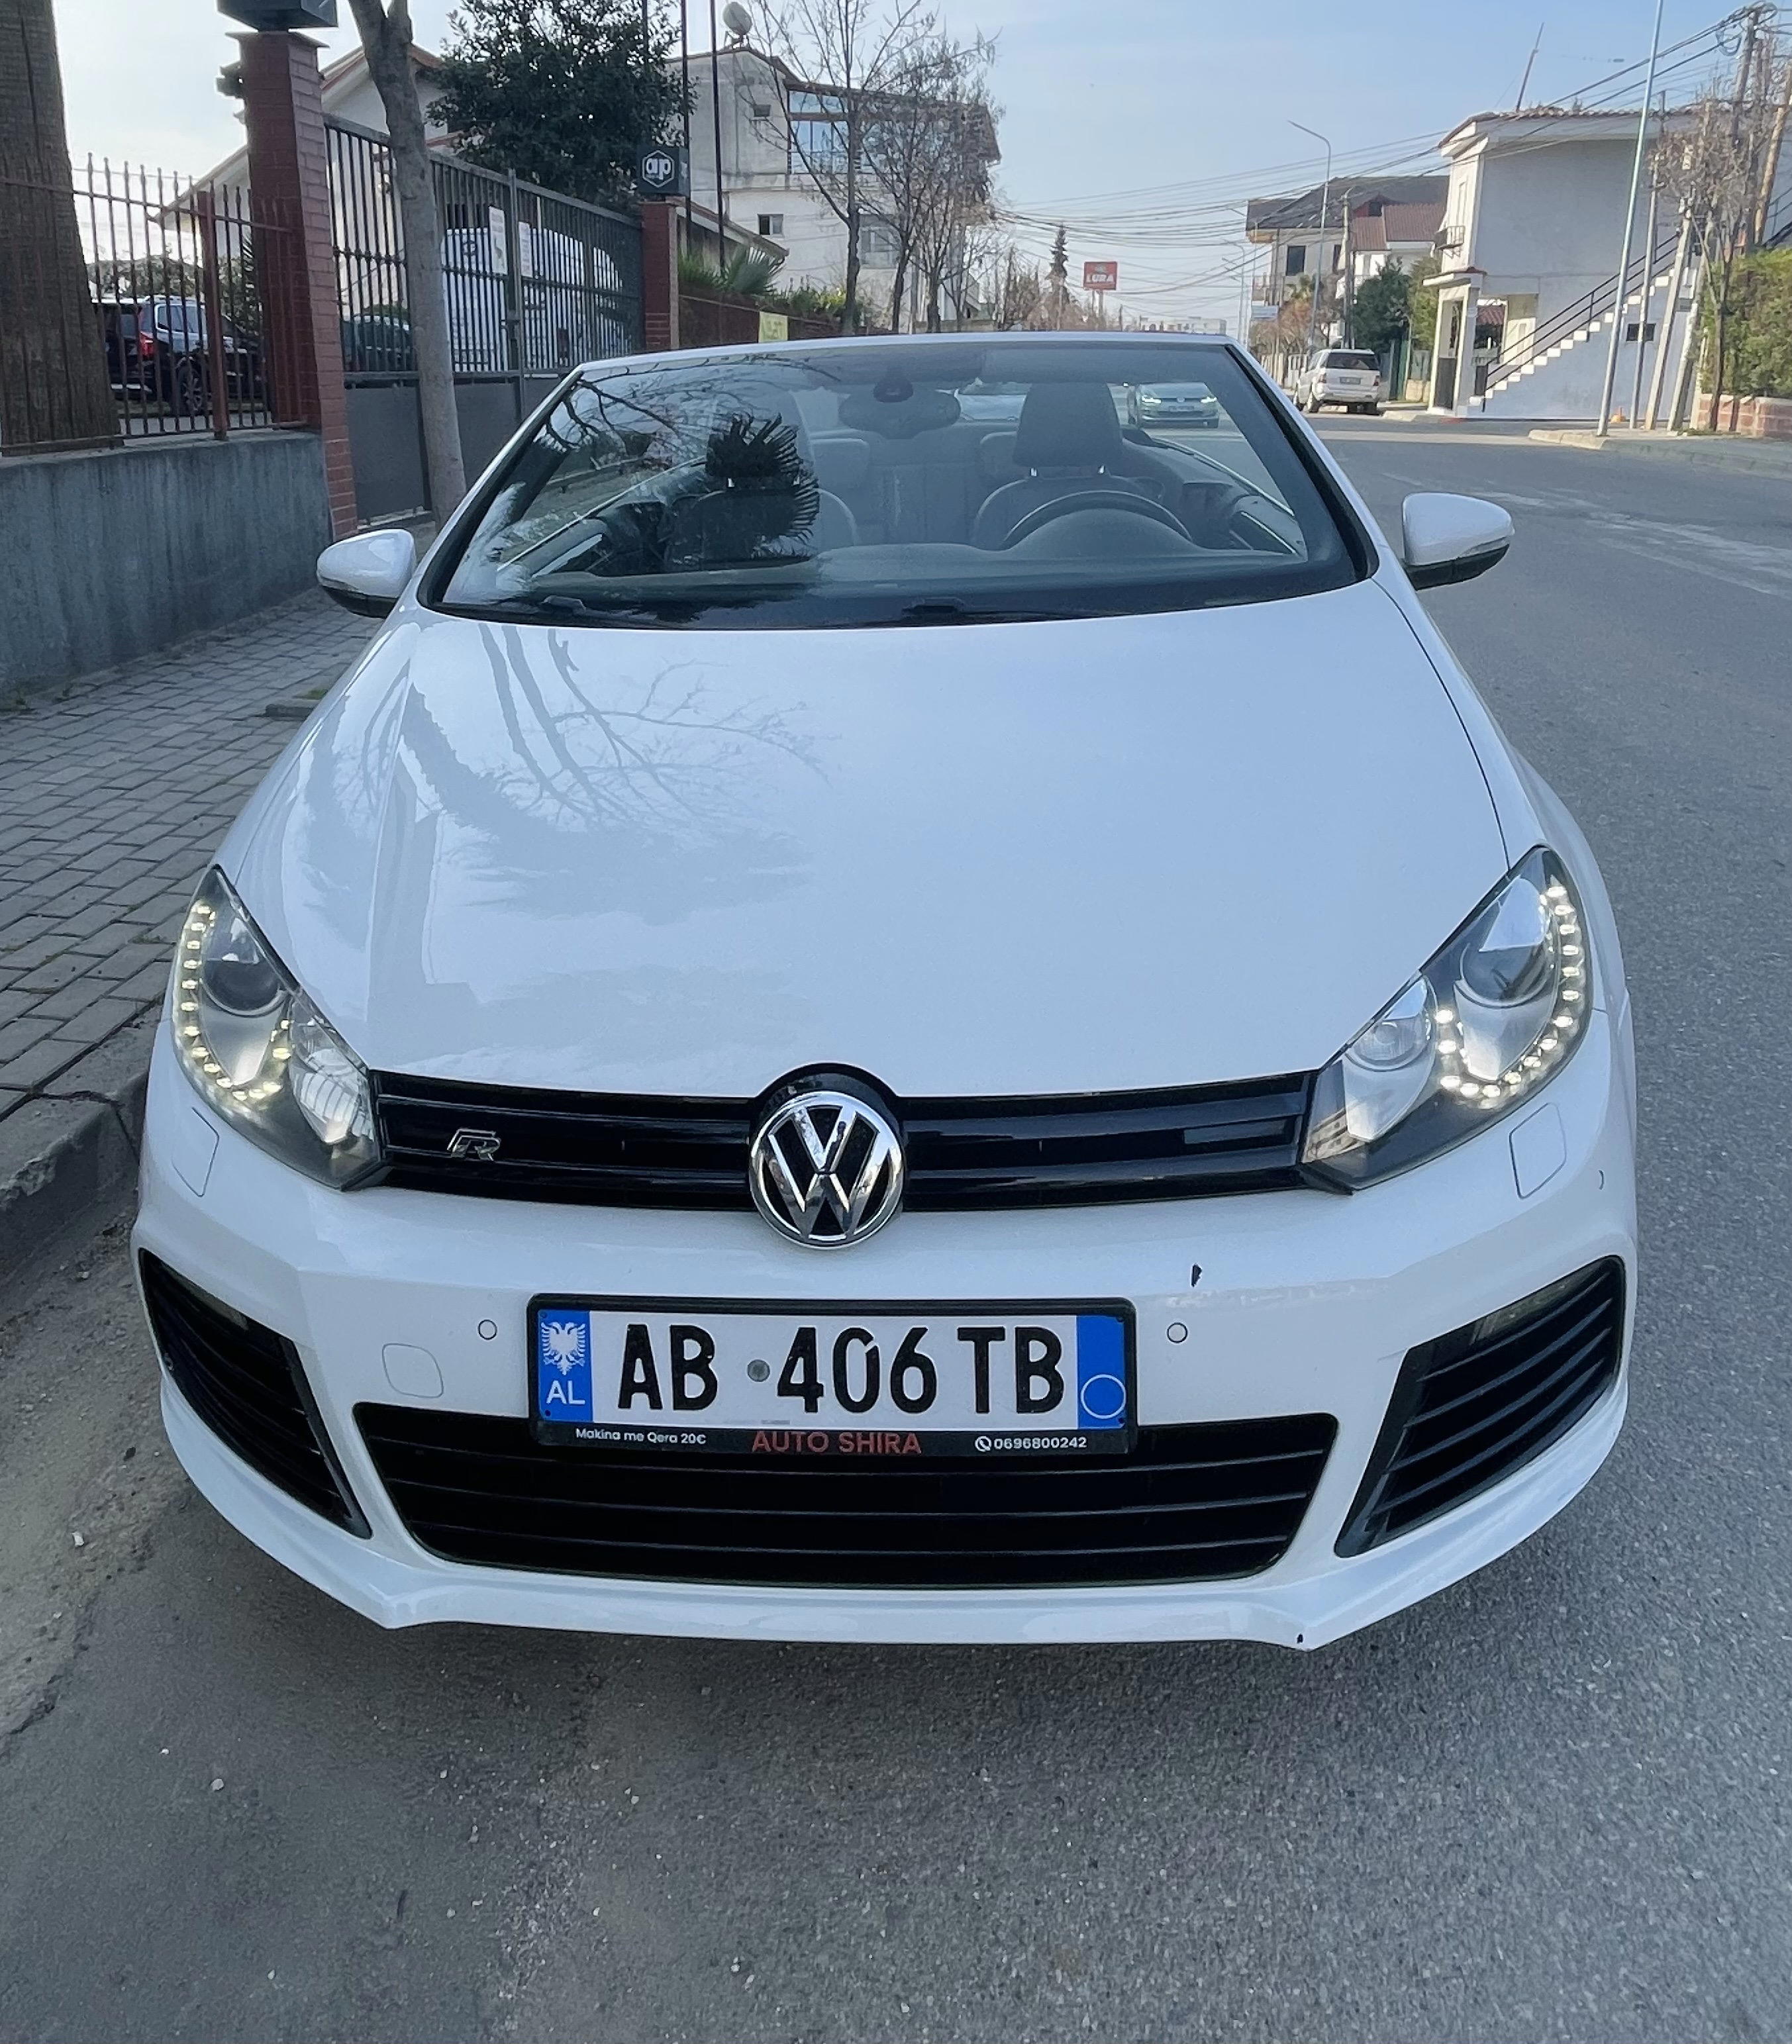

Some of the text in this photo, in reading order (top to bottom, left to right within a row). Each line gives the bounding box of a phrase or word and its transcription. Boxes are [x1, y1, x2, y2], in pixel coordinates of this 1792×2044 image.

[618, 1324, 1064, 1414] AB 406 TB
[546, 1380, 586, 1405] AL
[575, 1428, 621, 1440] Makina
[752, 1430, 922, 1454] AUTO SHIRA
